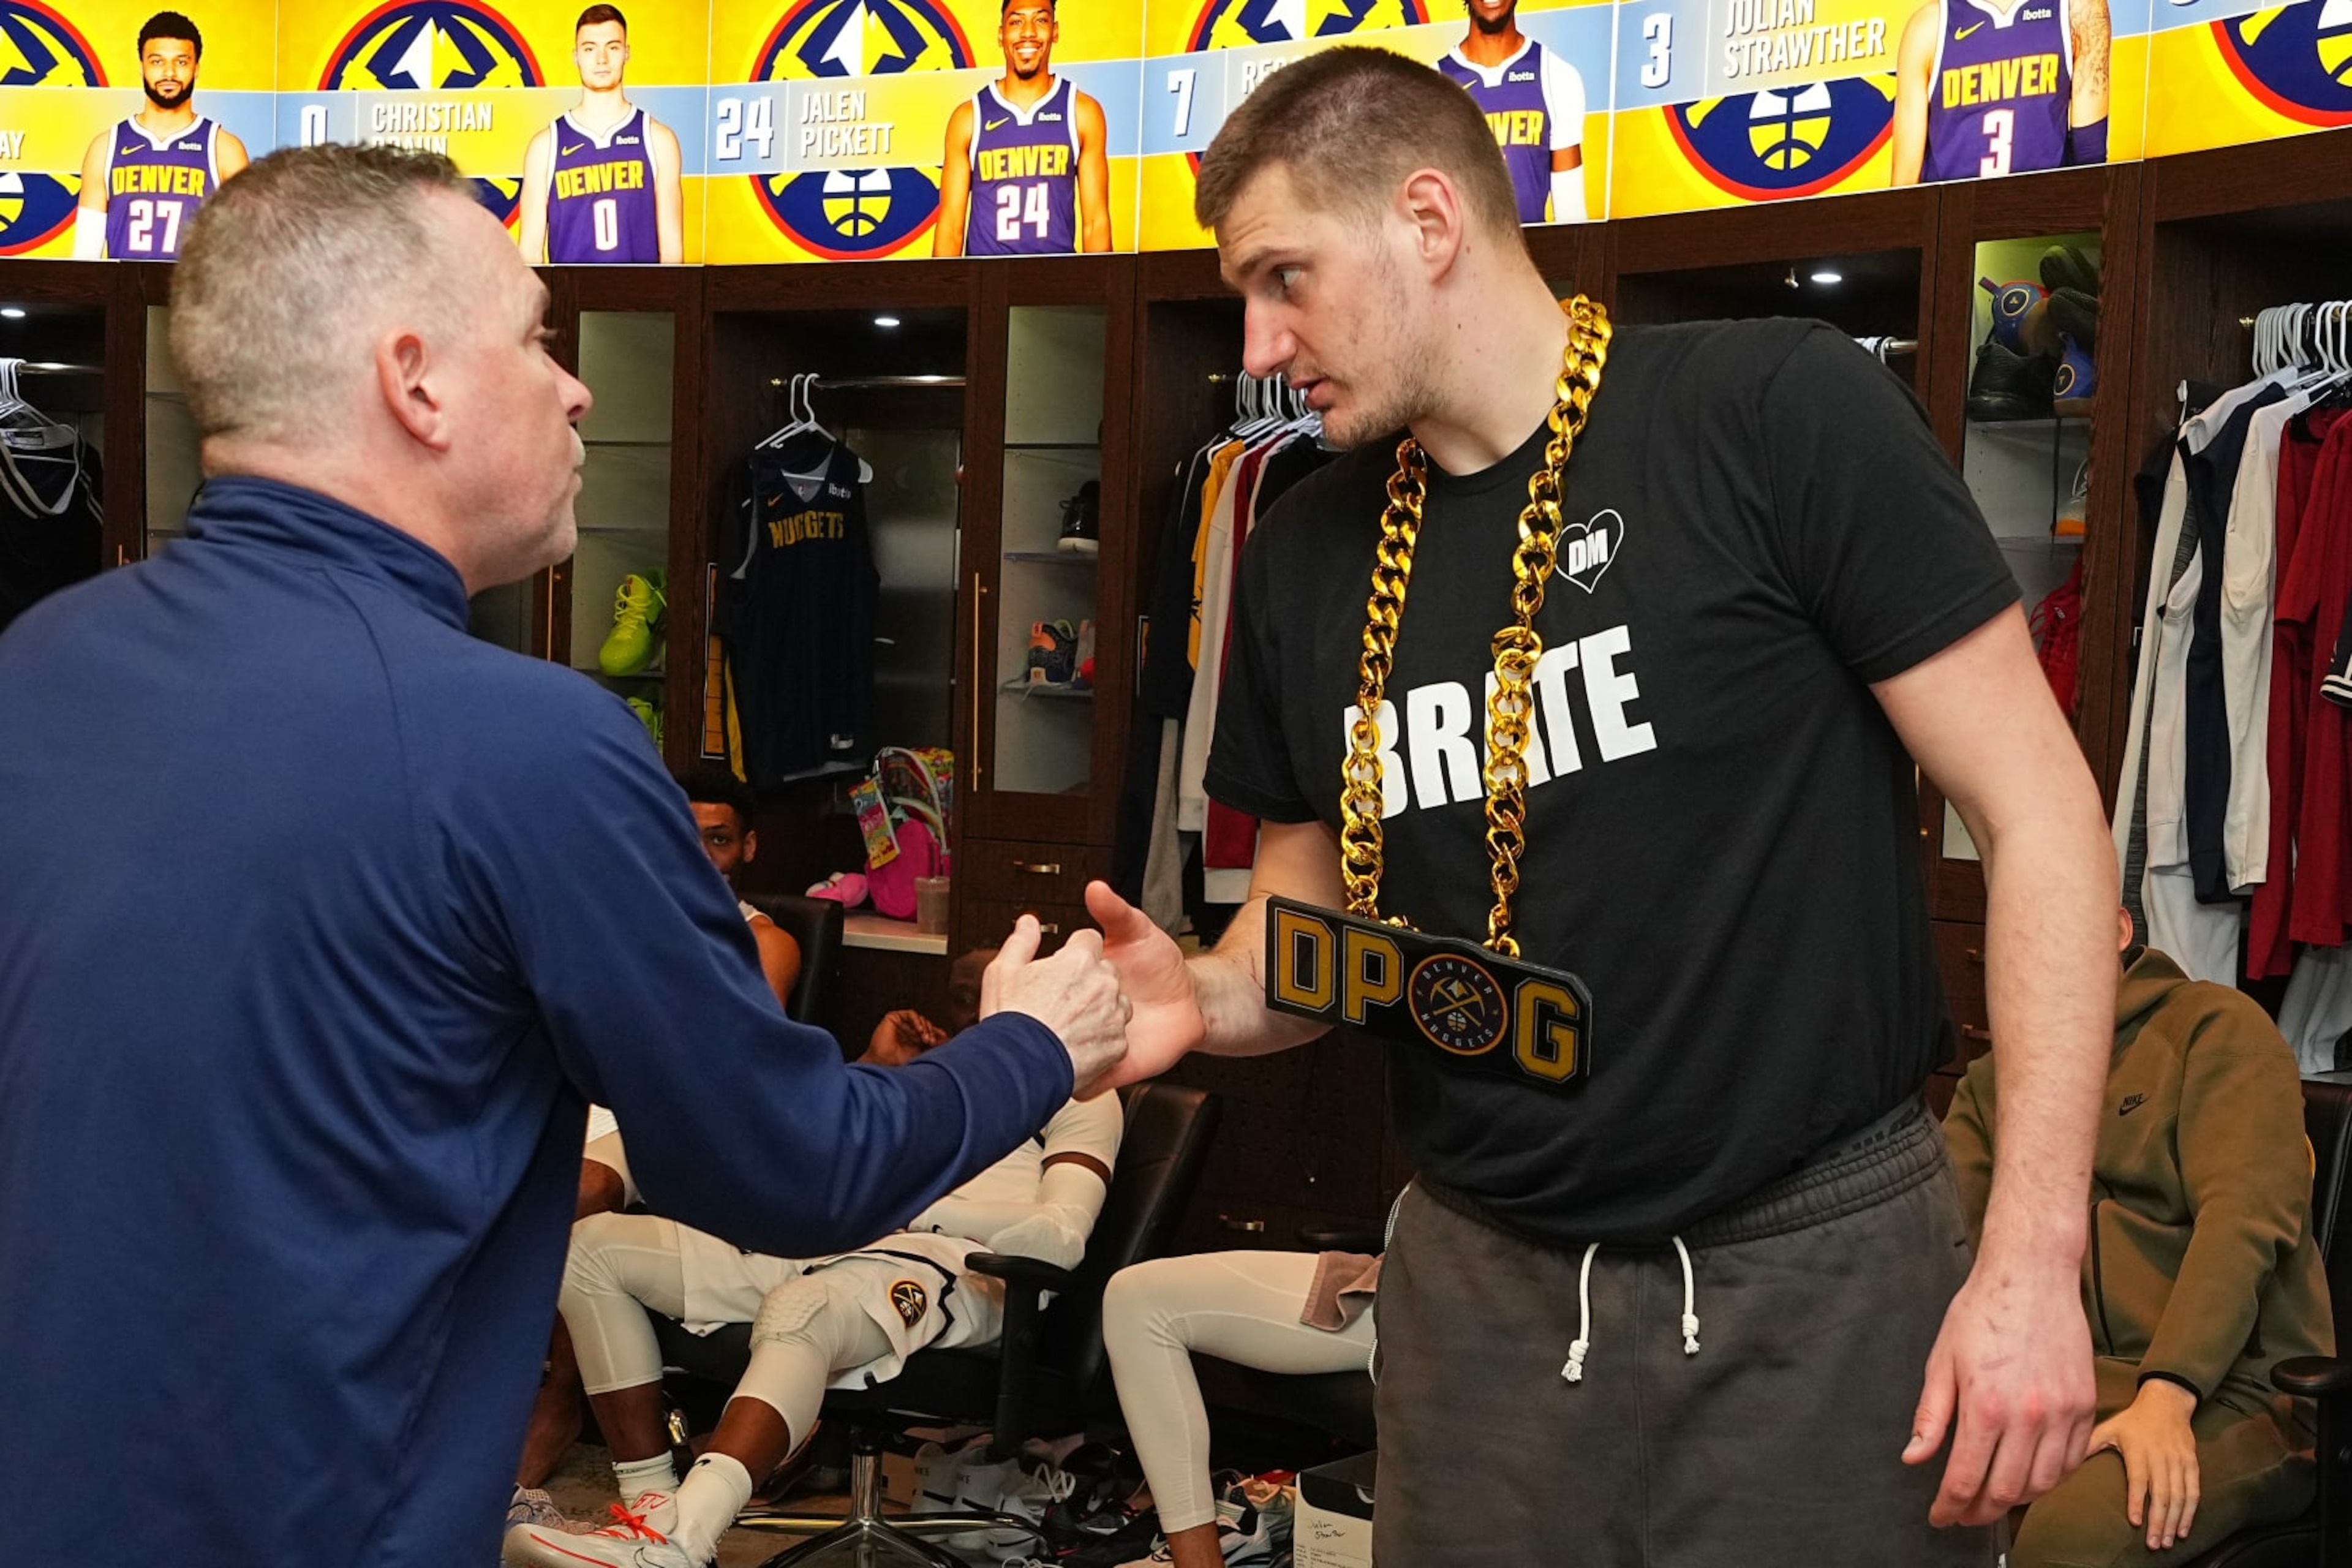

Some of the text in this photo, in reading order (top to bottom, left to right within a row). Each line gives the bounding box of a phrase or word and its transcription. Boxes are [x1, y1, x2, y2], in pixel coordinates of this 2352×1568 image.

[1725, 0, 1815, 37] JULIAN
[2022, 9, 2052, 21] ibotta
[1641, 12, 1673, 88] 3
[1723, 17, 1886, 78] STRAWTHER
[1942, 53, 2059, 109] DENVER
[372, 102, 493, 132] CHRISTIAN
[801, 91, 866, 124] JALEN
[1167, 69, 1195, 137] 7
[715, 96, 774, 160] 24
[801, 123, 894, 158] PICKETT
[1980, 109, 2015, 178] 3
[111, 165, 205, 197] DENVER
[555, 160, 644, 200] DENVER
[978, 145, 1069, 181] DENVER
[129, 199, 183, 252] 27
[594, 198, 618, 251] 0
[997, 183, 1050, 241] 24
[768, 510, 844, 548] NUGGETS
[1569, 528, 1608, 576] DM
[1422, 961, 1493, 995] DENVER
[1420, 1012, 1494, 1048] NUGGETS
[2123, 1093, 2144, 1107] NIKE
